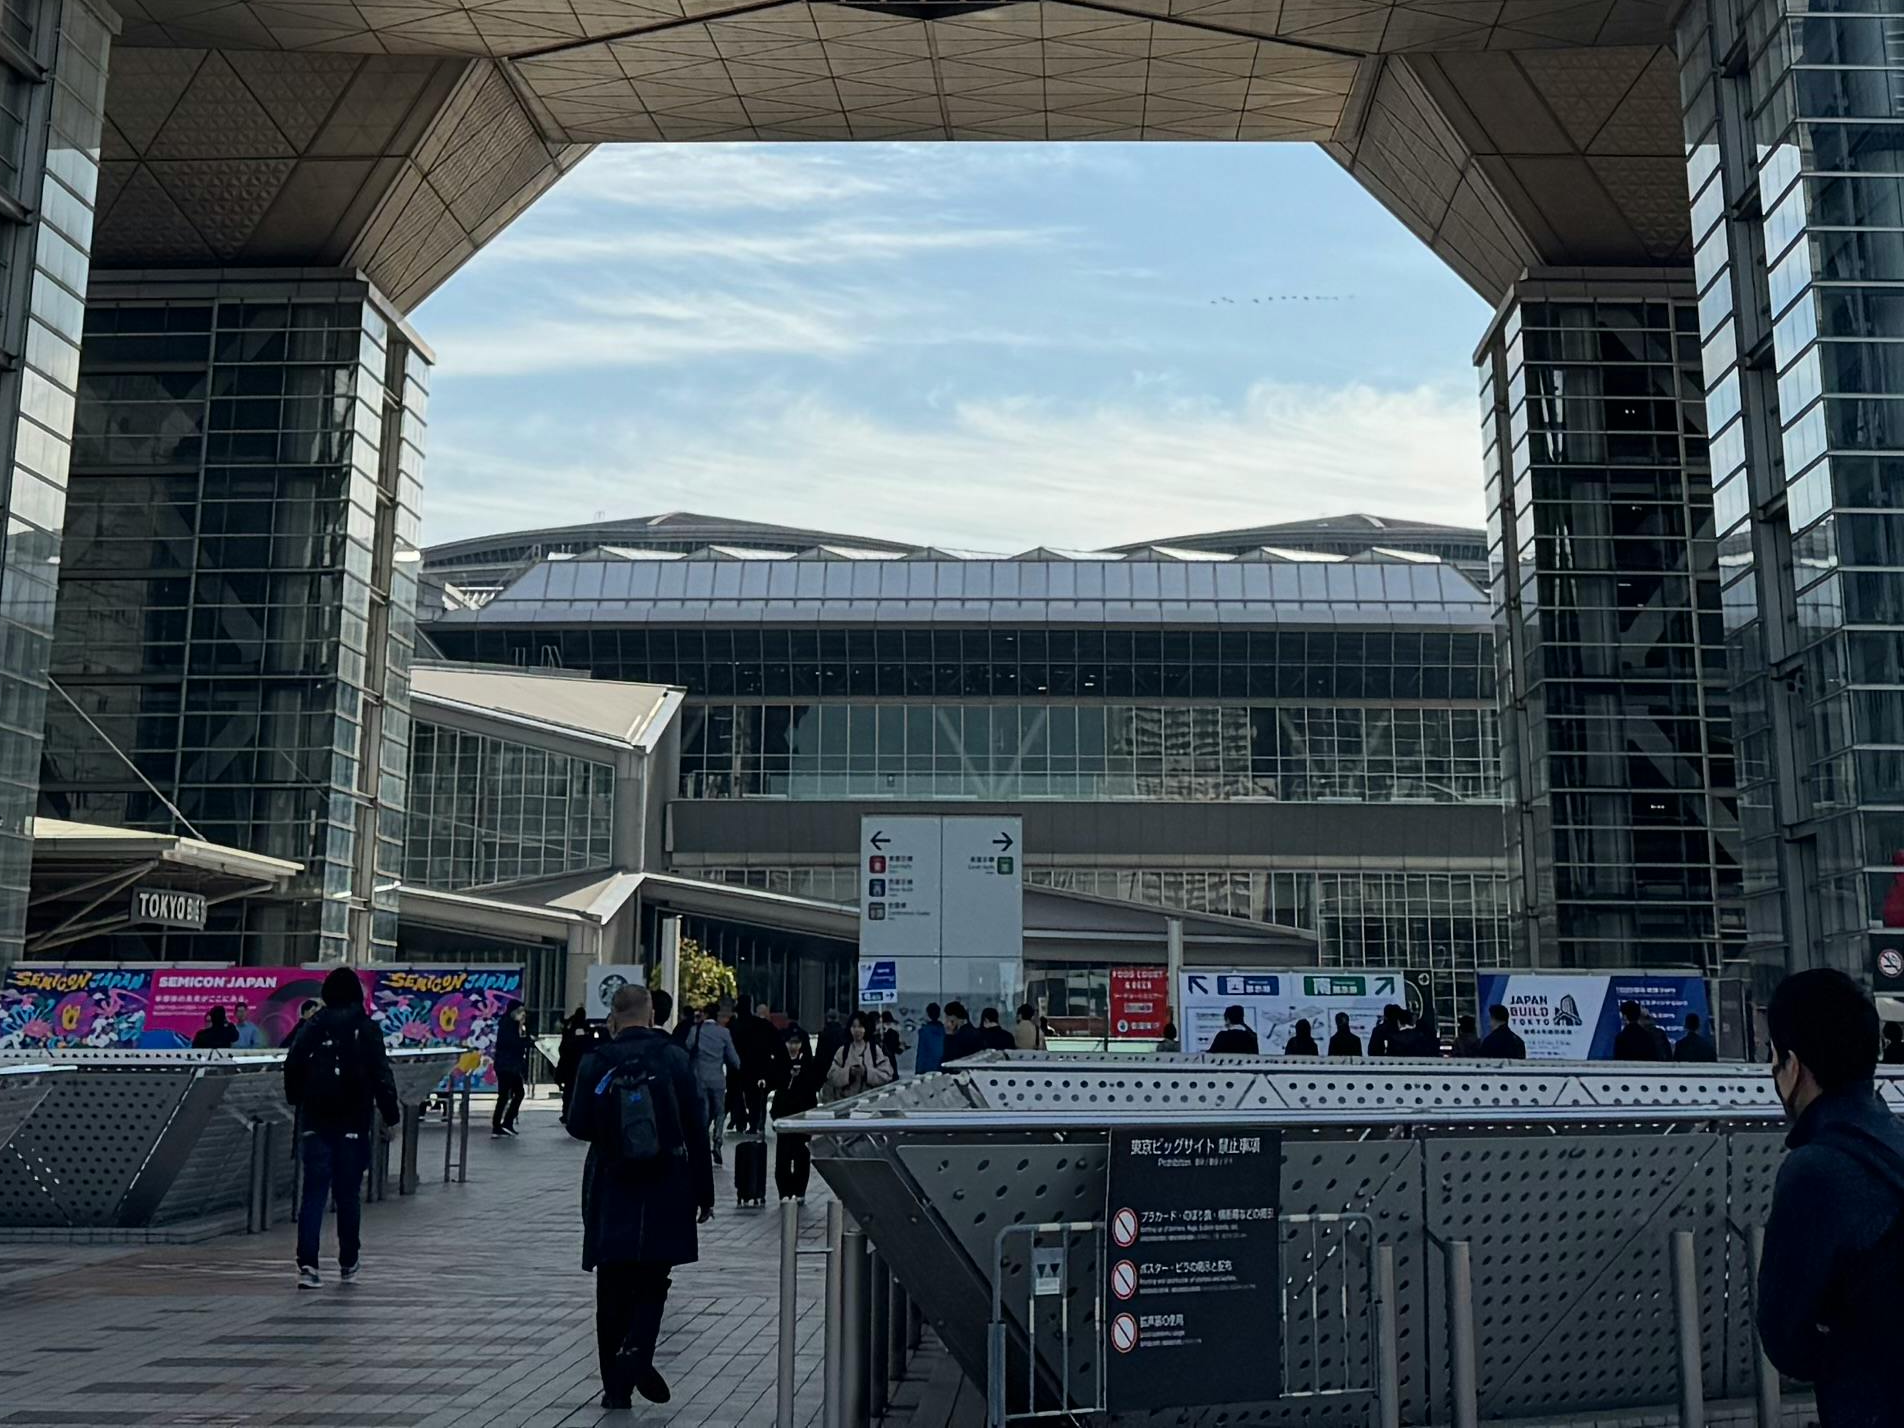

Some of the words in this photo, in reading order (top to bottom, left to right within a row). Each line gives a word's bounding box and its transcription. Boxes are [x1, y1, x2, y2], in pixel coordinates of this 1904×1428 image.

[139, 893, 185, 920] TOKYO
[10, 970, 93, 992] SEMICON
[89, 971, 145, 991] JAPAN
[159, 976, 226, 988] SEMICON
[227, 976, 277, 988] JAPAN
[386, 971, 467, 993] SEMICON
[464, 973, 520, 991] JAPAN
[1510, 995, 1548, 1005] JAPAN
[1509, 1007, 1549, 1017] BUILD
[1511, 1018, 1550, 1026] TOKYO
[1131, 1137, 1215, 1155] 東京ビッグサイト
[1218, 1137, 1261, 1154] 禁止事項
